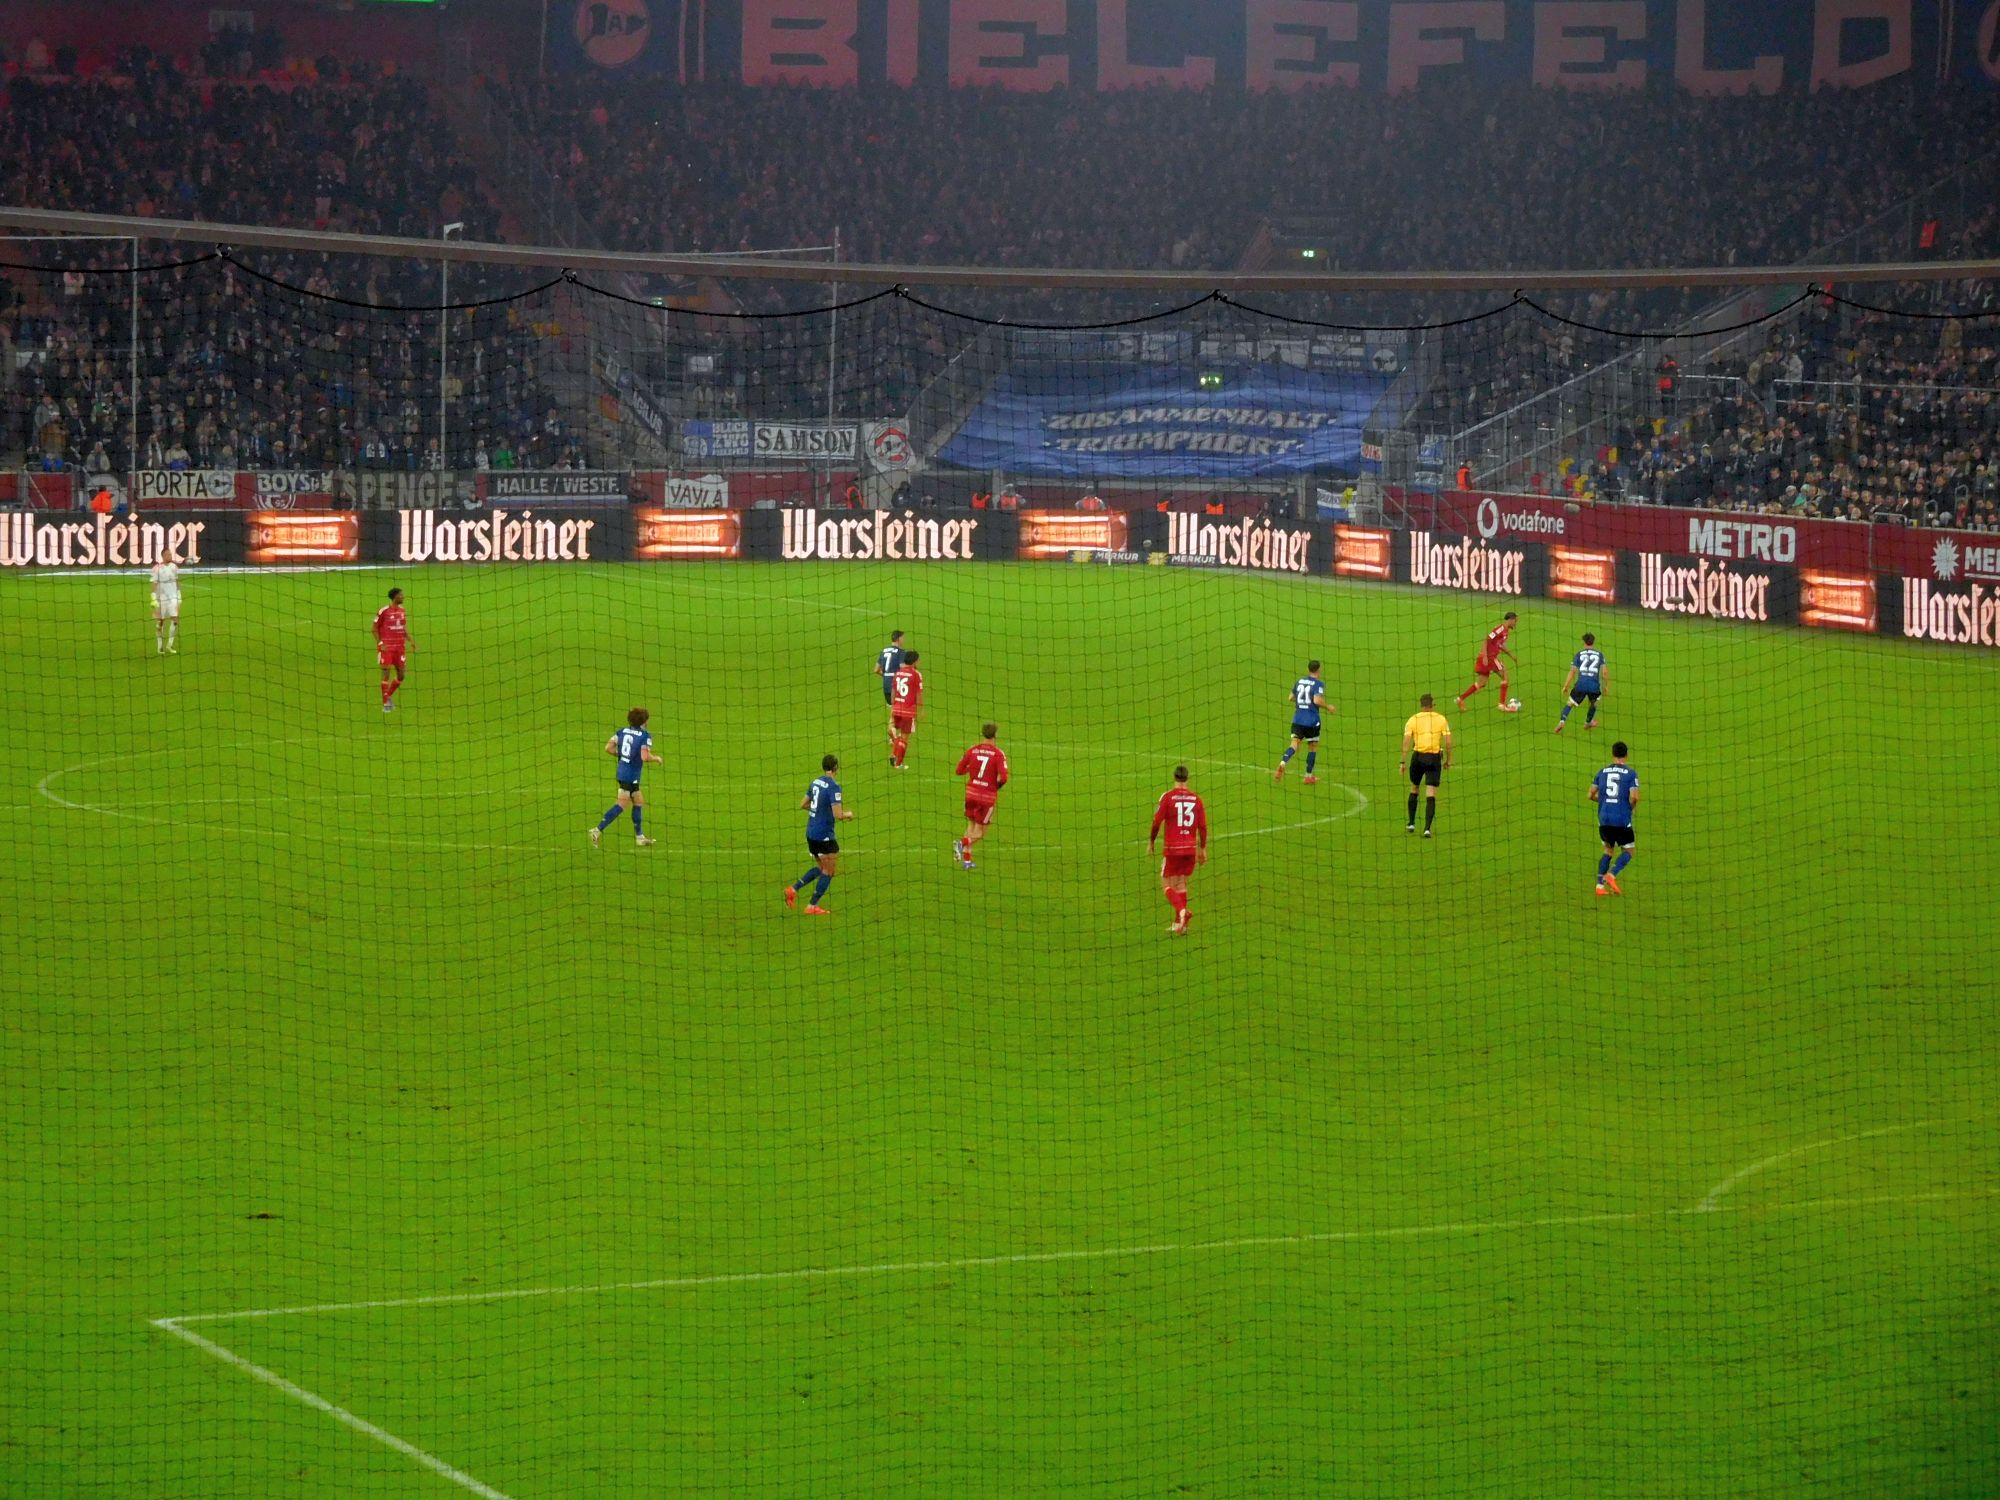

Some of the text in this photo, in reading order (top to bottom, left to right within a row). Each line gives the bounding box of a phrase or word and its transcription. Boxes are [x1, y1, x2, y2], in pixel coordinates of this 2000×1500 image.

[742, 0, 1912, 97] BIELEFELD
[1047, 407, 1328, 430] ZUSAMMENHALT
[756, 426, 854, 453] SAMSON
[142, 471, 208, 498] PORTA
[257, 472, 311, 493] BOYS
[342, 472, 455, 510] SPENGE
[497, 477, 549, 494] HALLE
[563, 476, 620, 494] WESTF.
[399, 509, 595, 561] Warsteiner
[780, 508, 978, 560] Warsteiner
[1502, 509, 1565, 535] vodafone
[0, 512, 205, 566] Warsteiner
[1166, 511, 1312, 572] Warsteiner
[1689, 517, 1796, 563] METRO
[1095, 551, 1139, 561] MERKUR
[1171, 555, 1216, 564] MERKUR
[1410, 530, 1525, 594] Warsteiner
[1639, 552, 1769, 621] Warsteiner
[1579, 653, 1600, 674] 22
[895, 676, 909, 697] 16
[1296, 683, 1312, 705] 21
[621, 734, 634, 757] 6
[976, 755, 990, 779] 7
[810, 785, 820, 809] 3
[1605, 772, 1620, 798] 5
[1174, 801, 1196, 827] 13
